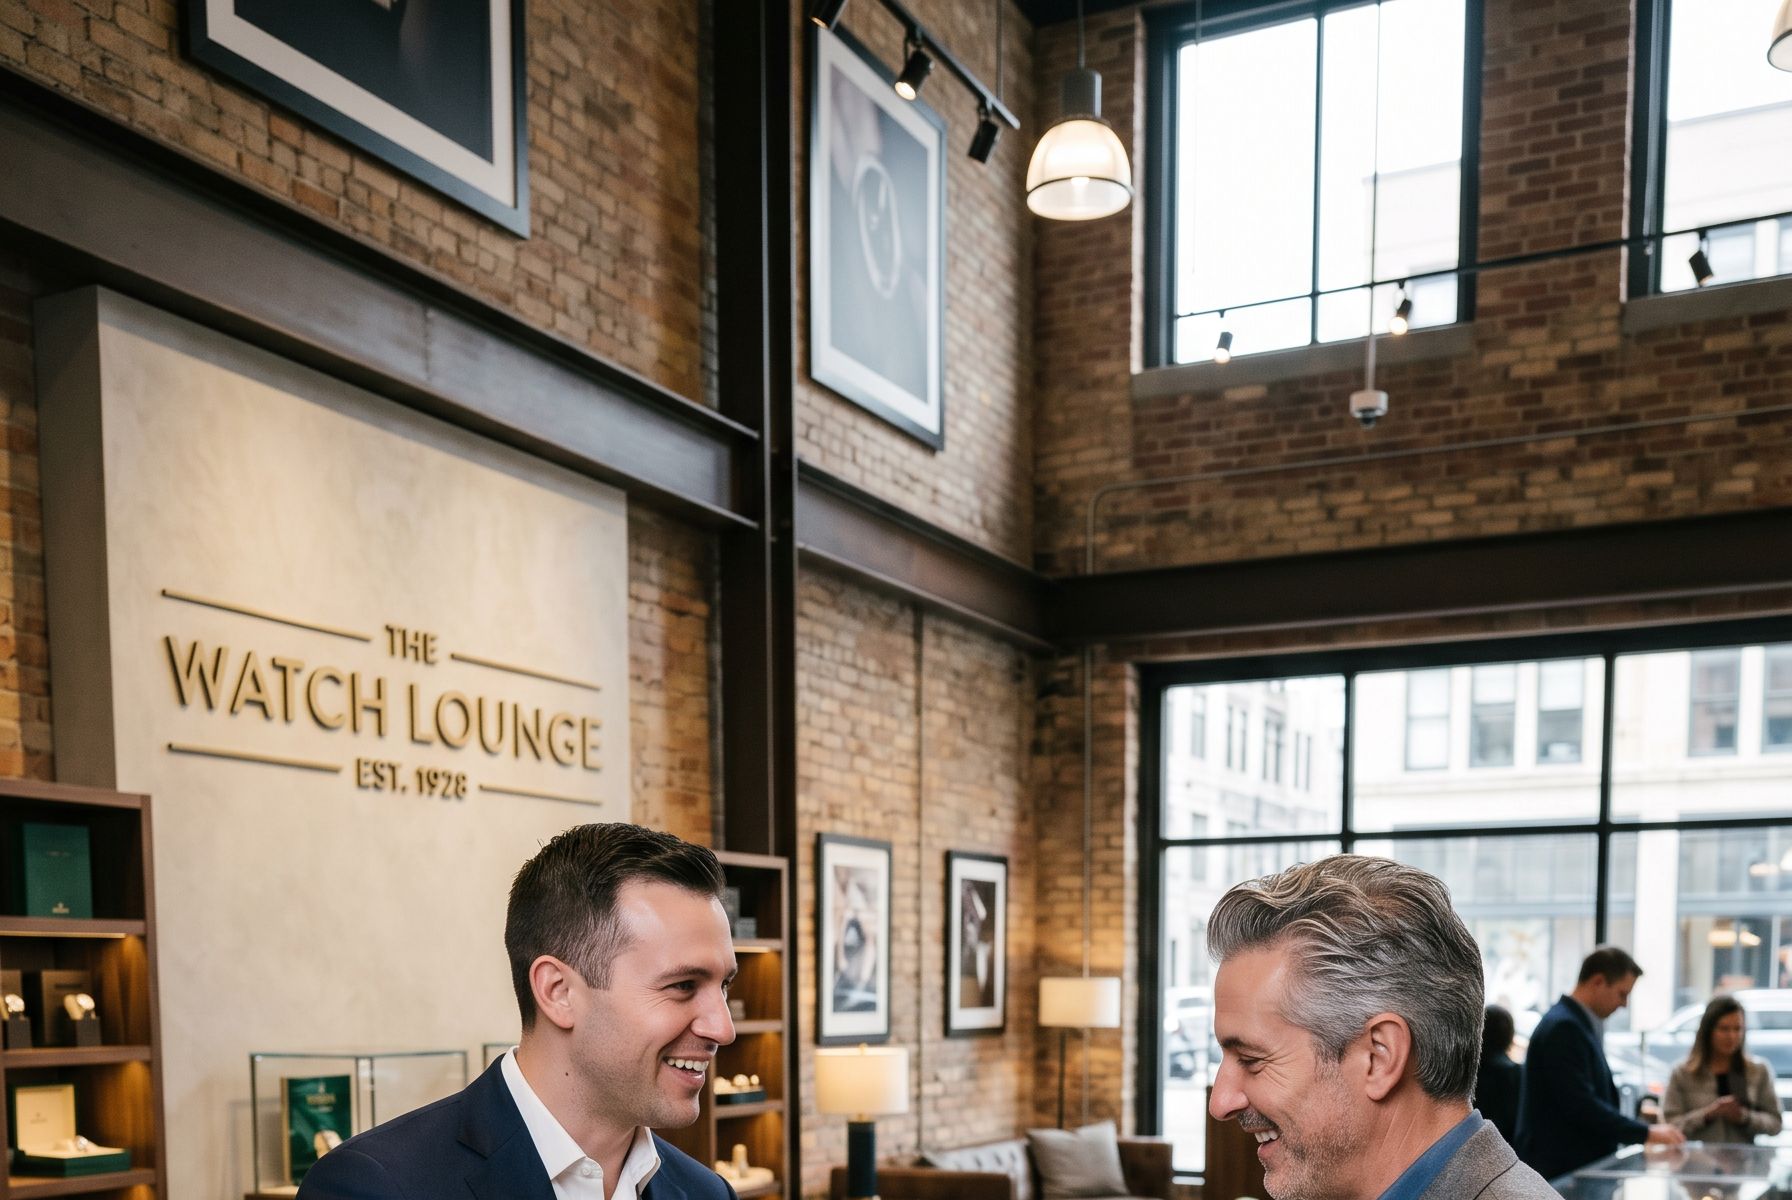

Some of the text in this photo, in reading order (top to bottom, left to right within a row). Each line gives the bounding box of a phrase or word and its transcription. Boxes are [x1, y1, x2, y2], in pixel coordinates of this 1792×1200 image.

[385, 625, 437, 665] THE
[164, 634, 603, 771] WATCH LOUNGE
[356, 757, 468, 800] EST. 1928
